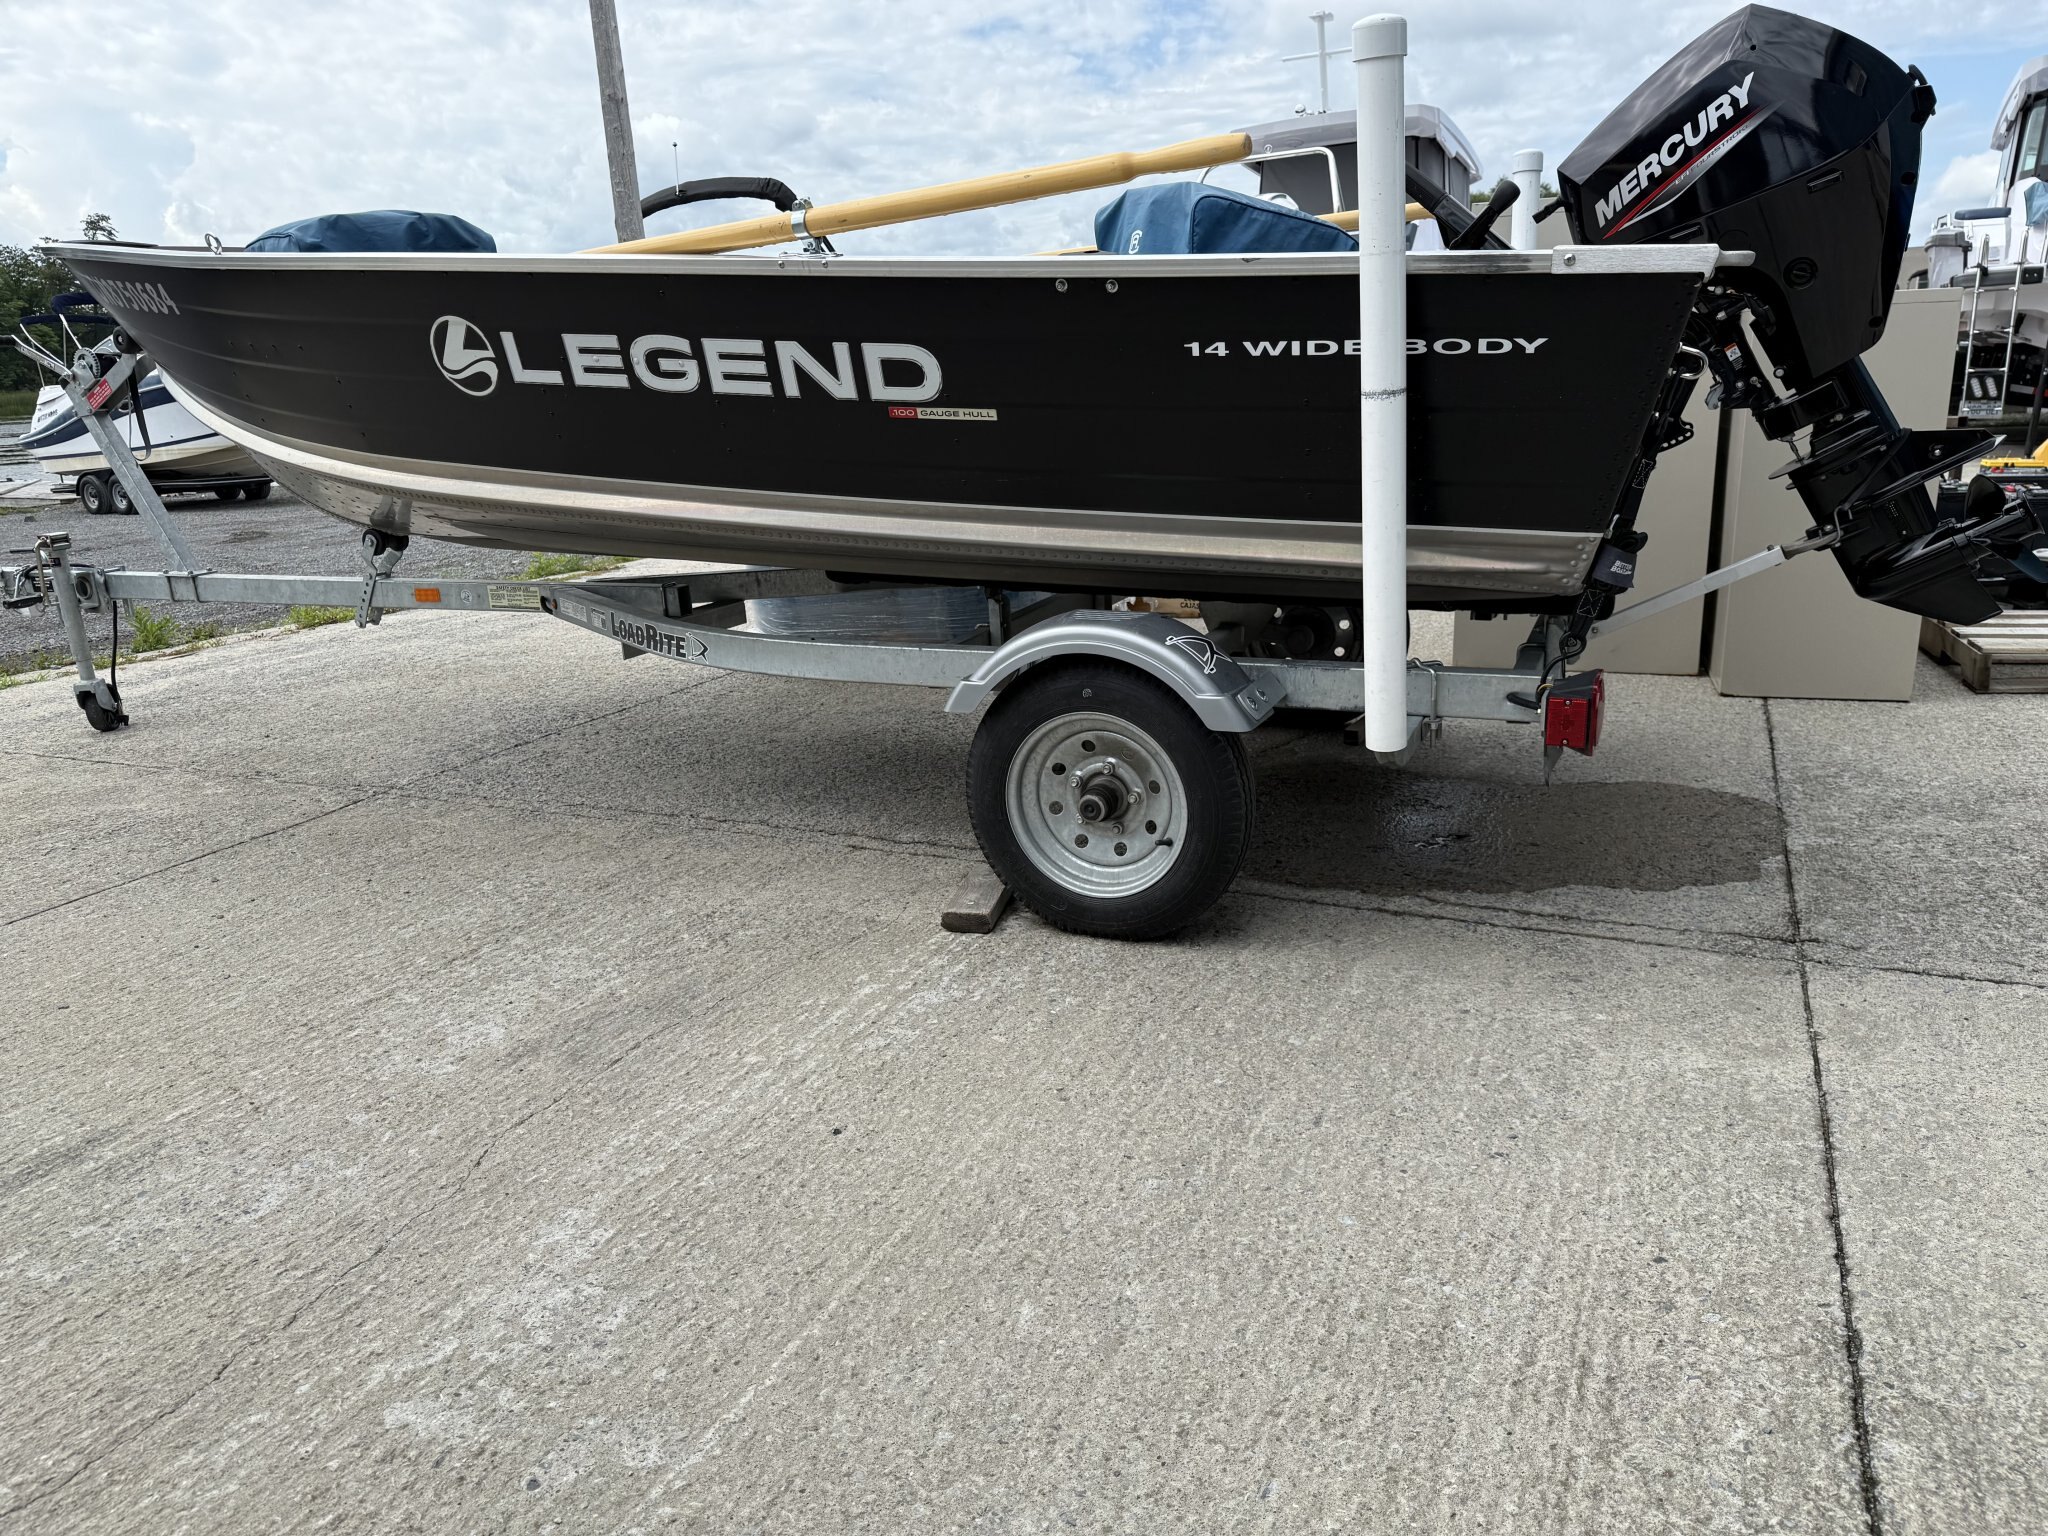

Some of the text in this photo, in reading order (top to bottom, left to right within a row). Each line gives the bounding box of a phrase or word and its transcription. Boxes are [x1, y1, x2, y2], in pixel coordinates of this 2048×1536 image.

[1594, 71, 1755, 229] MERCURY
[499, 331, 943, 404] LEGEND
[1184, 337, 1550, 357] 14 WIDE BODY
[920, 409, 960, 418] GAUGE
